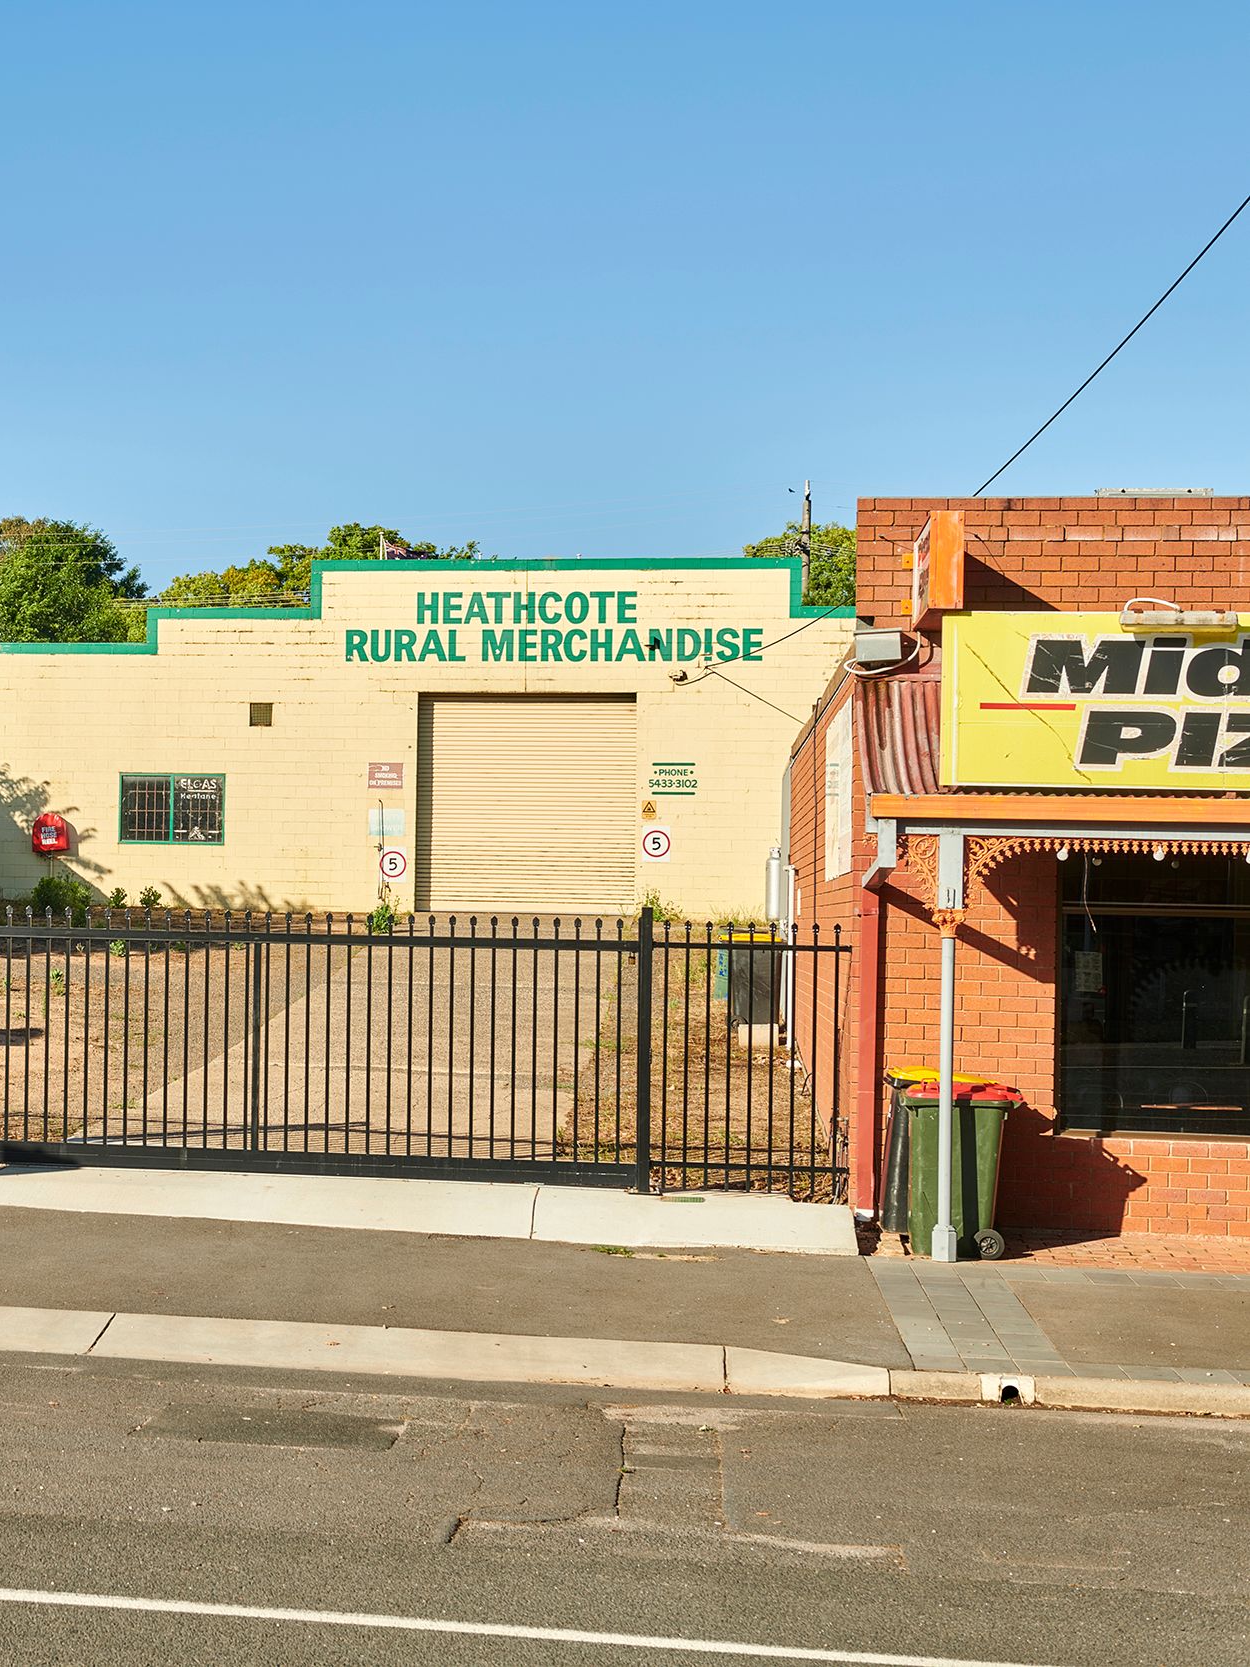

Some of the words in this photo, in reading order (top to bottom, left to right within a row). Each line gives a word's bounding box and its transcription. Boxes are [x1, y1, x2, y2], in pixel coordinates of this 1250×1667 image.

[417, 591, 638, 625] HEATHCOTE
[345, 629, 467, 662] RURAL
[481, 628, 764, 662] MERCHANDISE
[658, 768, 689, 776] PHONE
[180, 779, 217, 790] ELGAS
[652, 837, 661, 850] 5
[388, 858, 397, 871] 5
